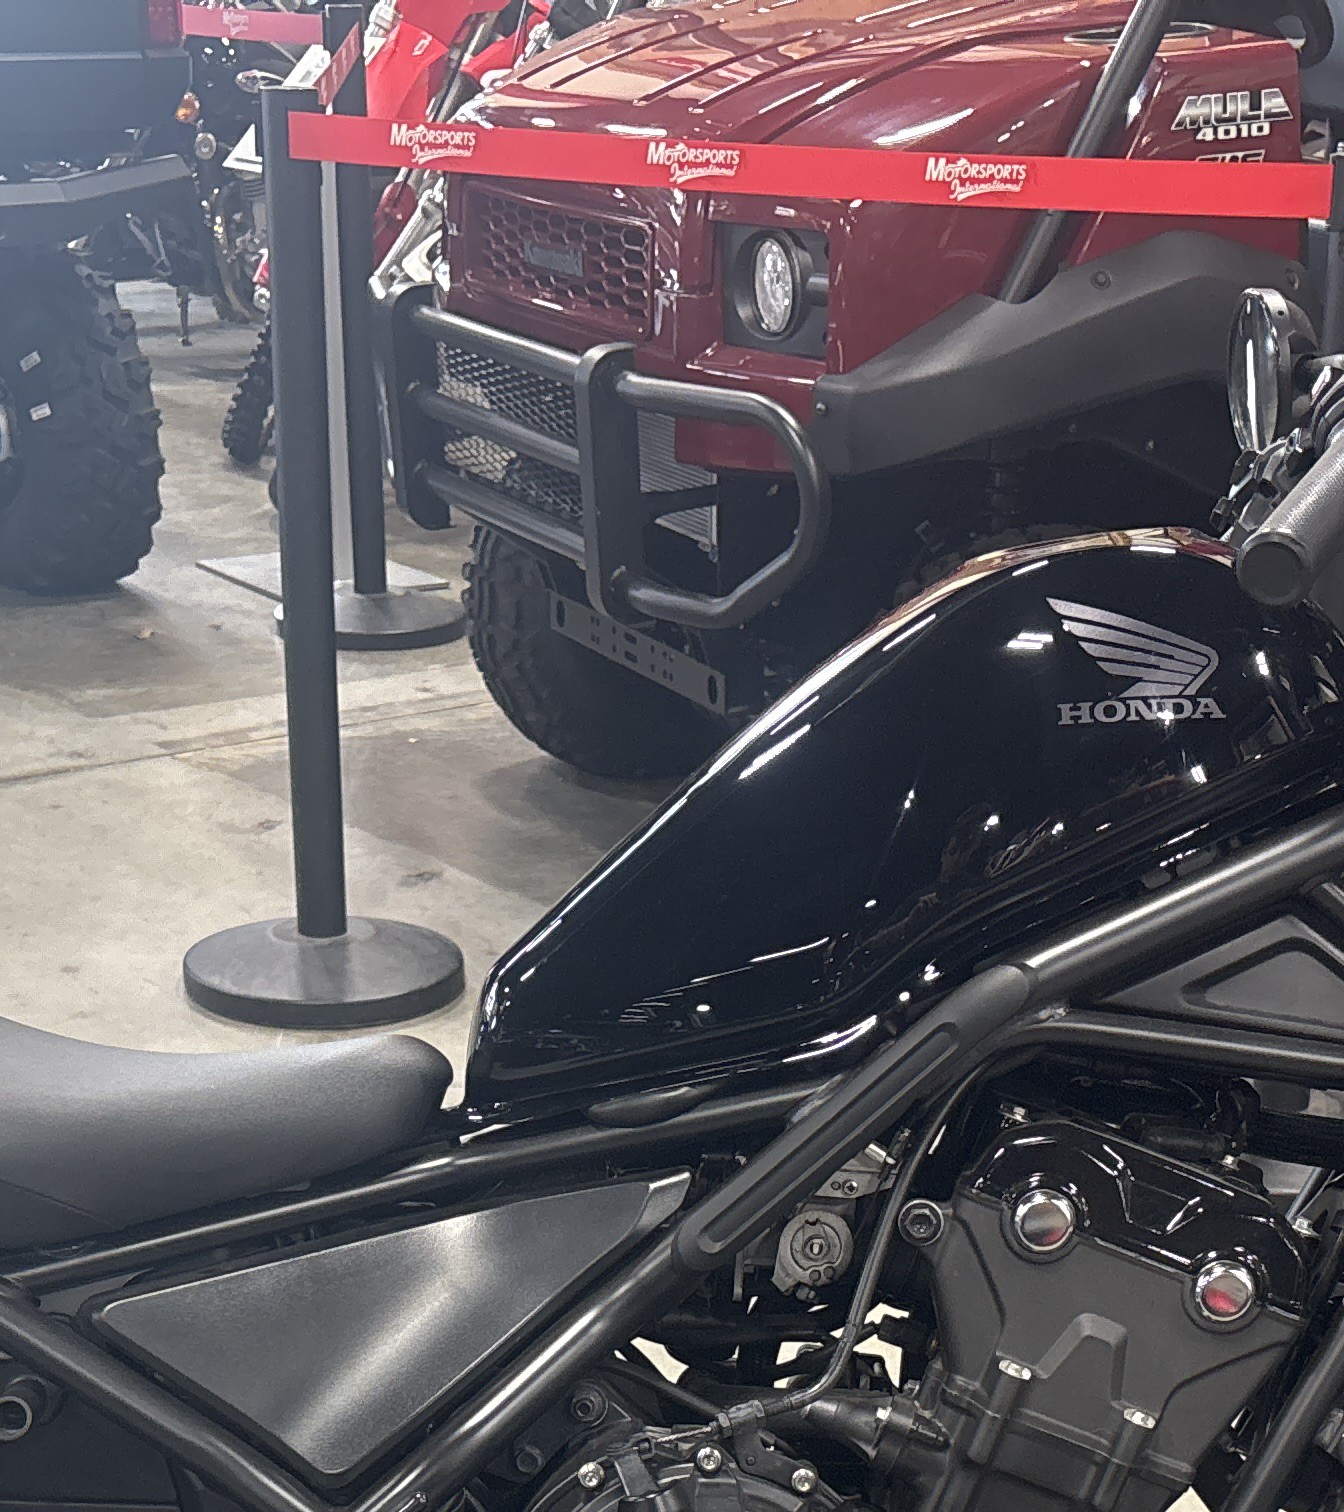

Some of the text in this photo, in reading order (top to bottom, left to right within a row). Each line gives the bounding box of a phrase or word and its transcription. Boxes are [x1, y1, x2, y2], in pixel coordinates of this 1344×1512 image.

[1171, 87, 1294, 131] MULE
[390, 123, 476, 147] MOTORSPORTS
[1196, 121, 1271, 142] 4010
[646, 141, 741, 165] MOTORSPORTS
[925, 157, 1027, 181] MOTORSPORTS
[1057, 697, 1227, 726] HONDA
